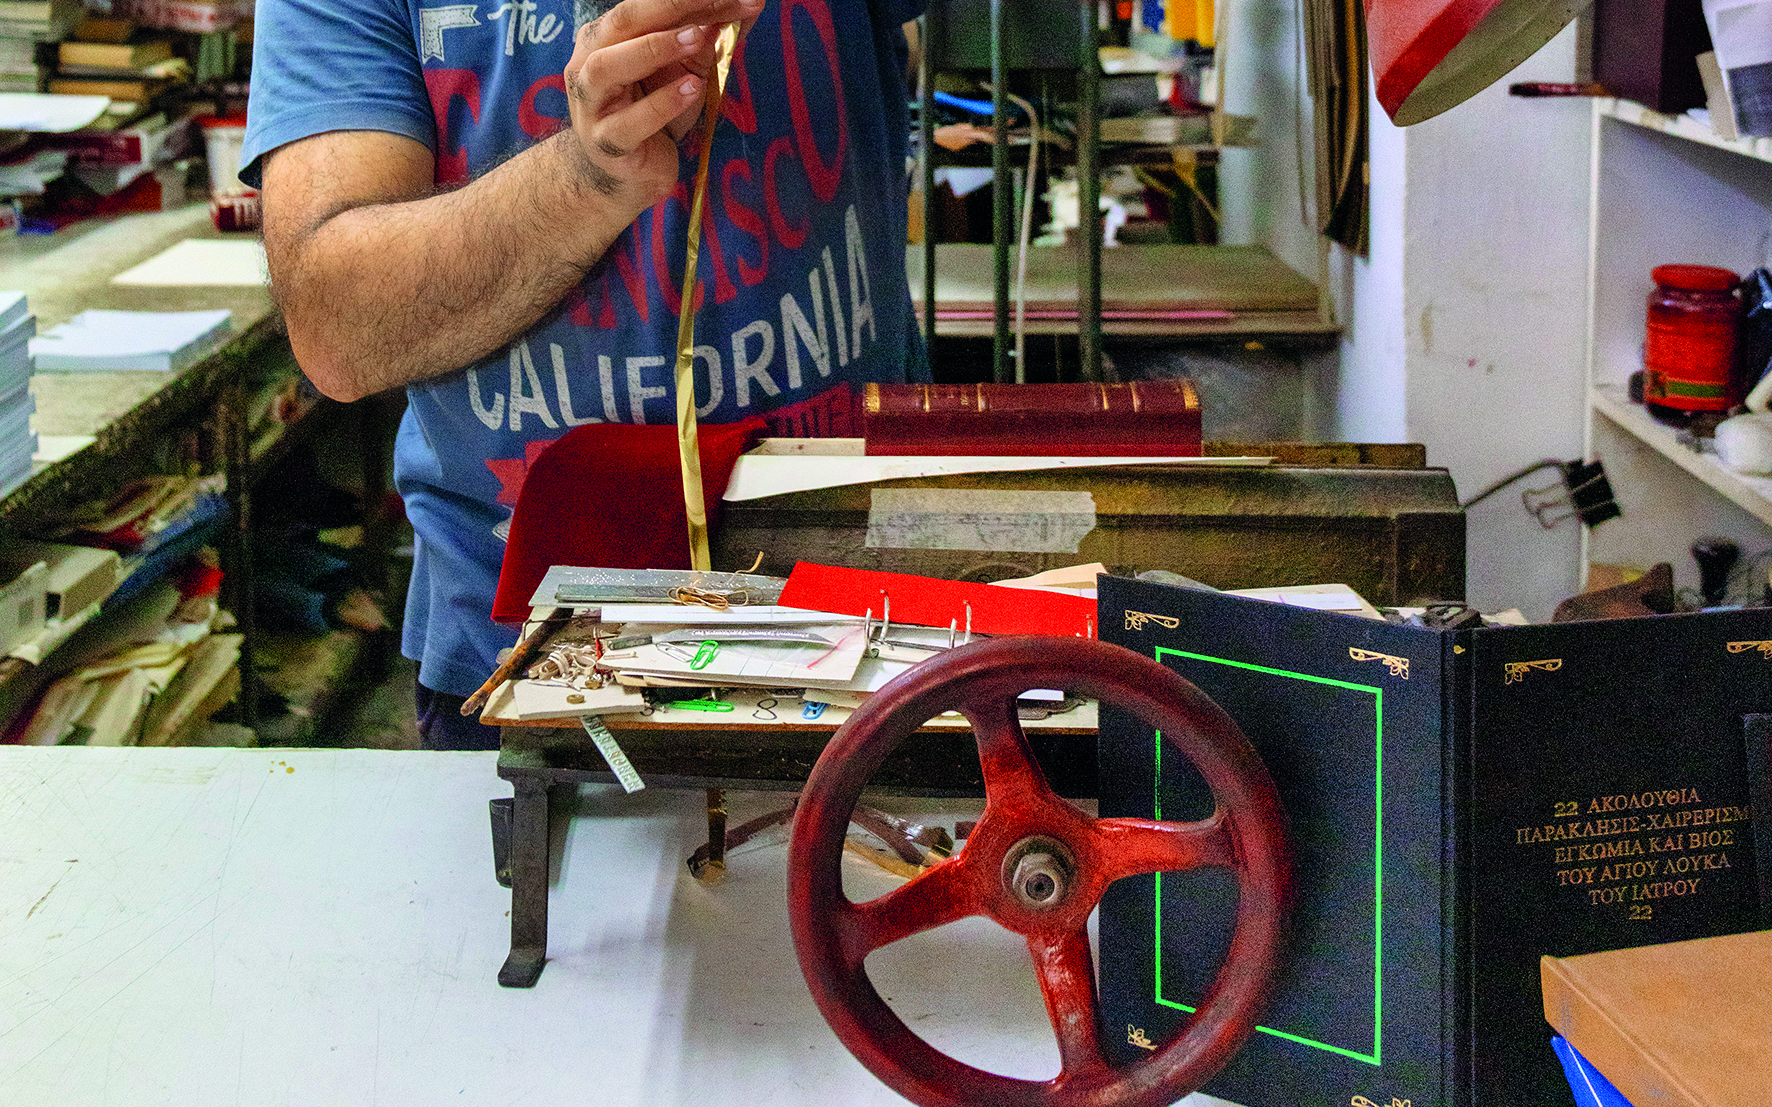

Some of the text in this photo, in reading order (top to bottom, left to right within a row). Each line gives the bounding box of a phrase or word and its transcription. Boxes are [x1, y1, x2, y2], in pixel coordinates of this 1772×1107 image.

[487, 0, 564, 56] The
[467, 203, 876, 431] CALIFORNIA
[1587, 788, 1701, 814] ΑΚΟΛΟΥΘΙΑ
[1555, 830, 1734, 863] ΕΓΚΩΜΙΑ ΚΑΙ ΒΙΟΣ
[1557, 853, 1731, 886] ΤΟΥ ΑΓΙΟΥ ΛΟΥΚΑ
[1589, 878, 1701, 905] ΤΟΥ ΙΑΤΡΟΥ
